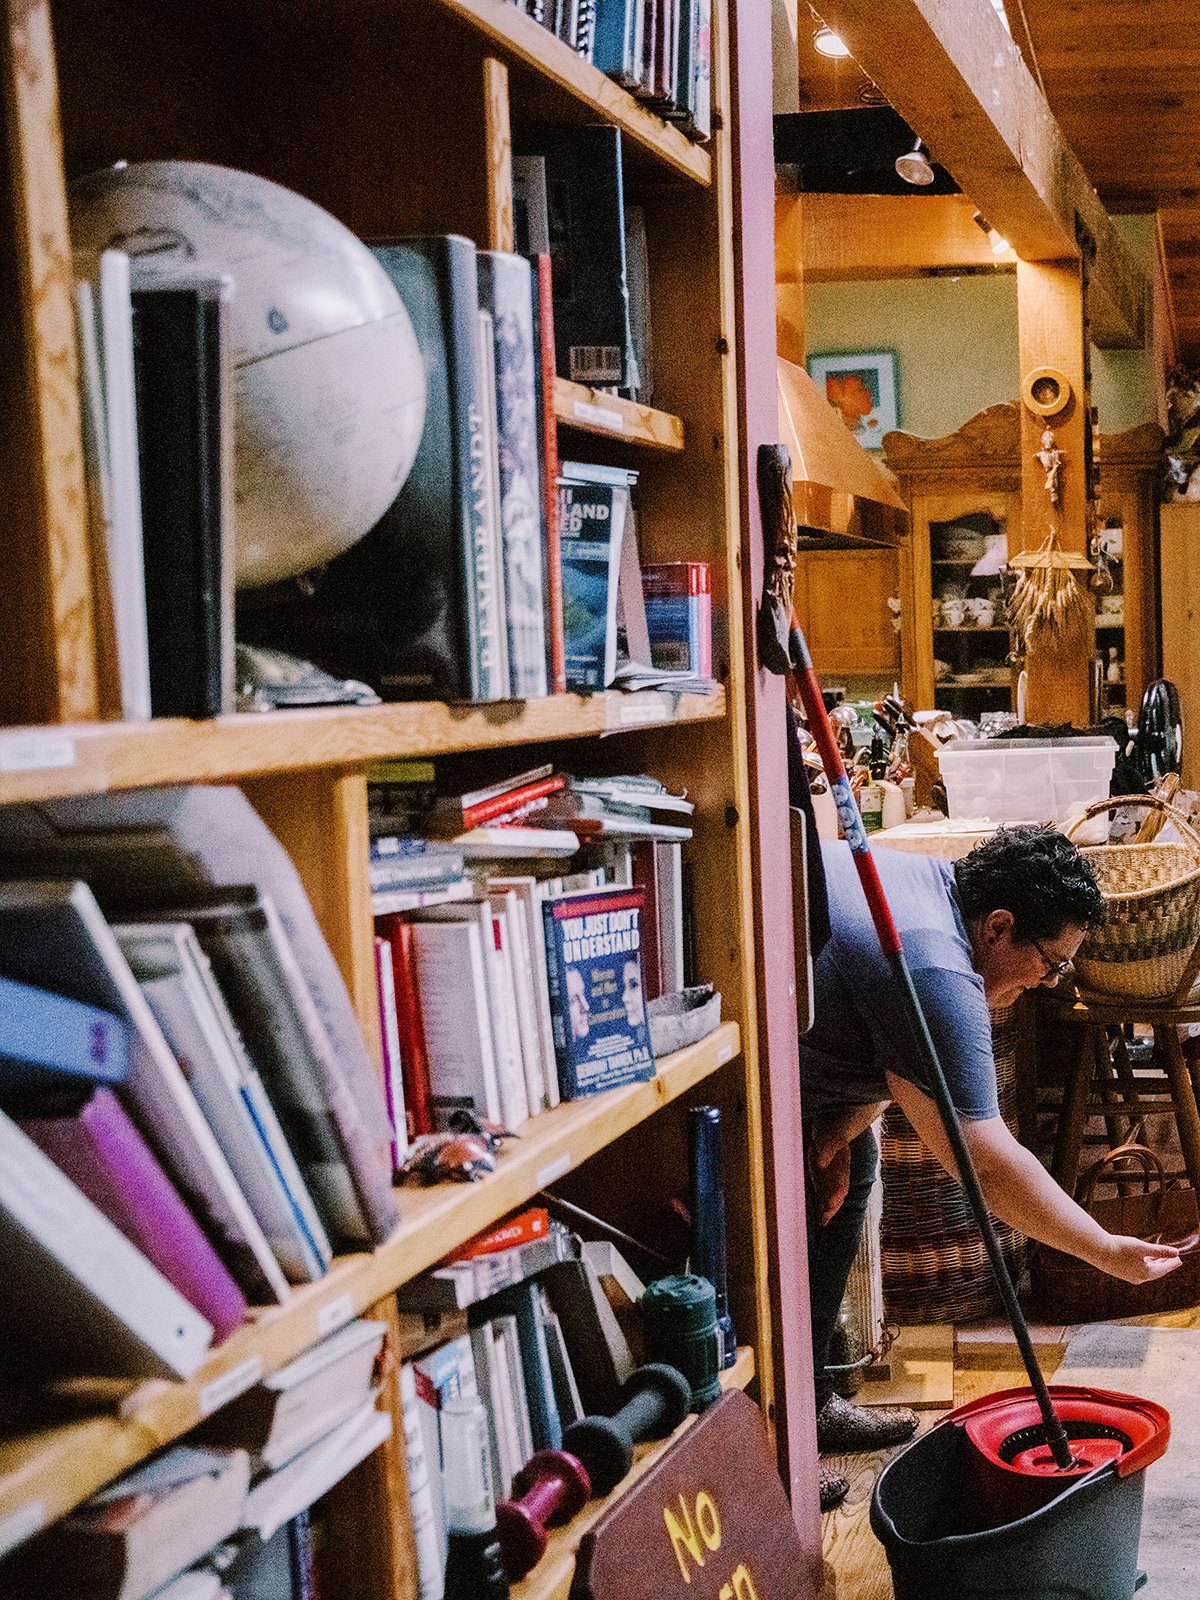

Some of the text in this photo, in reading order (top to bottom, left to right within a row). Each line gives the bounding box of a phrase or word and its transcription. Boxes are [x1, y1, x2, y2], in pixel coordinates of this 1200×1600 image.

[560, 502, 610, 521] LAND
[467, 402, 494, 668] REMBRANDT
[561, 916, 583, 941] YOU
[583, 911, 609, 937] JUST
[609, 907, 640, 932] DON'T
[563, 928, 640, 964] UNDERSTAND
